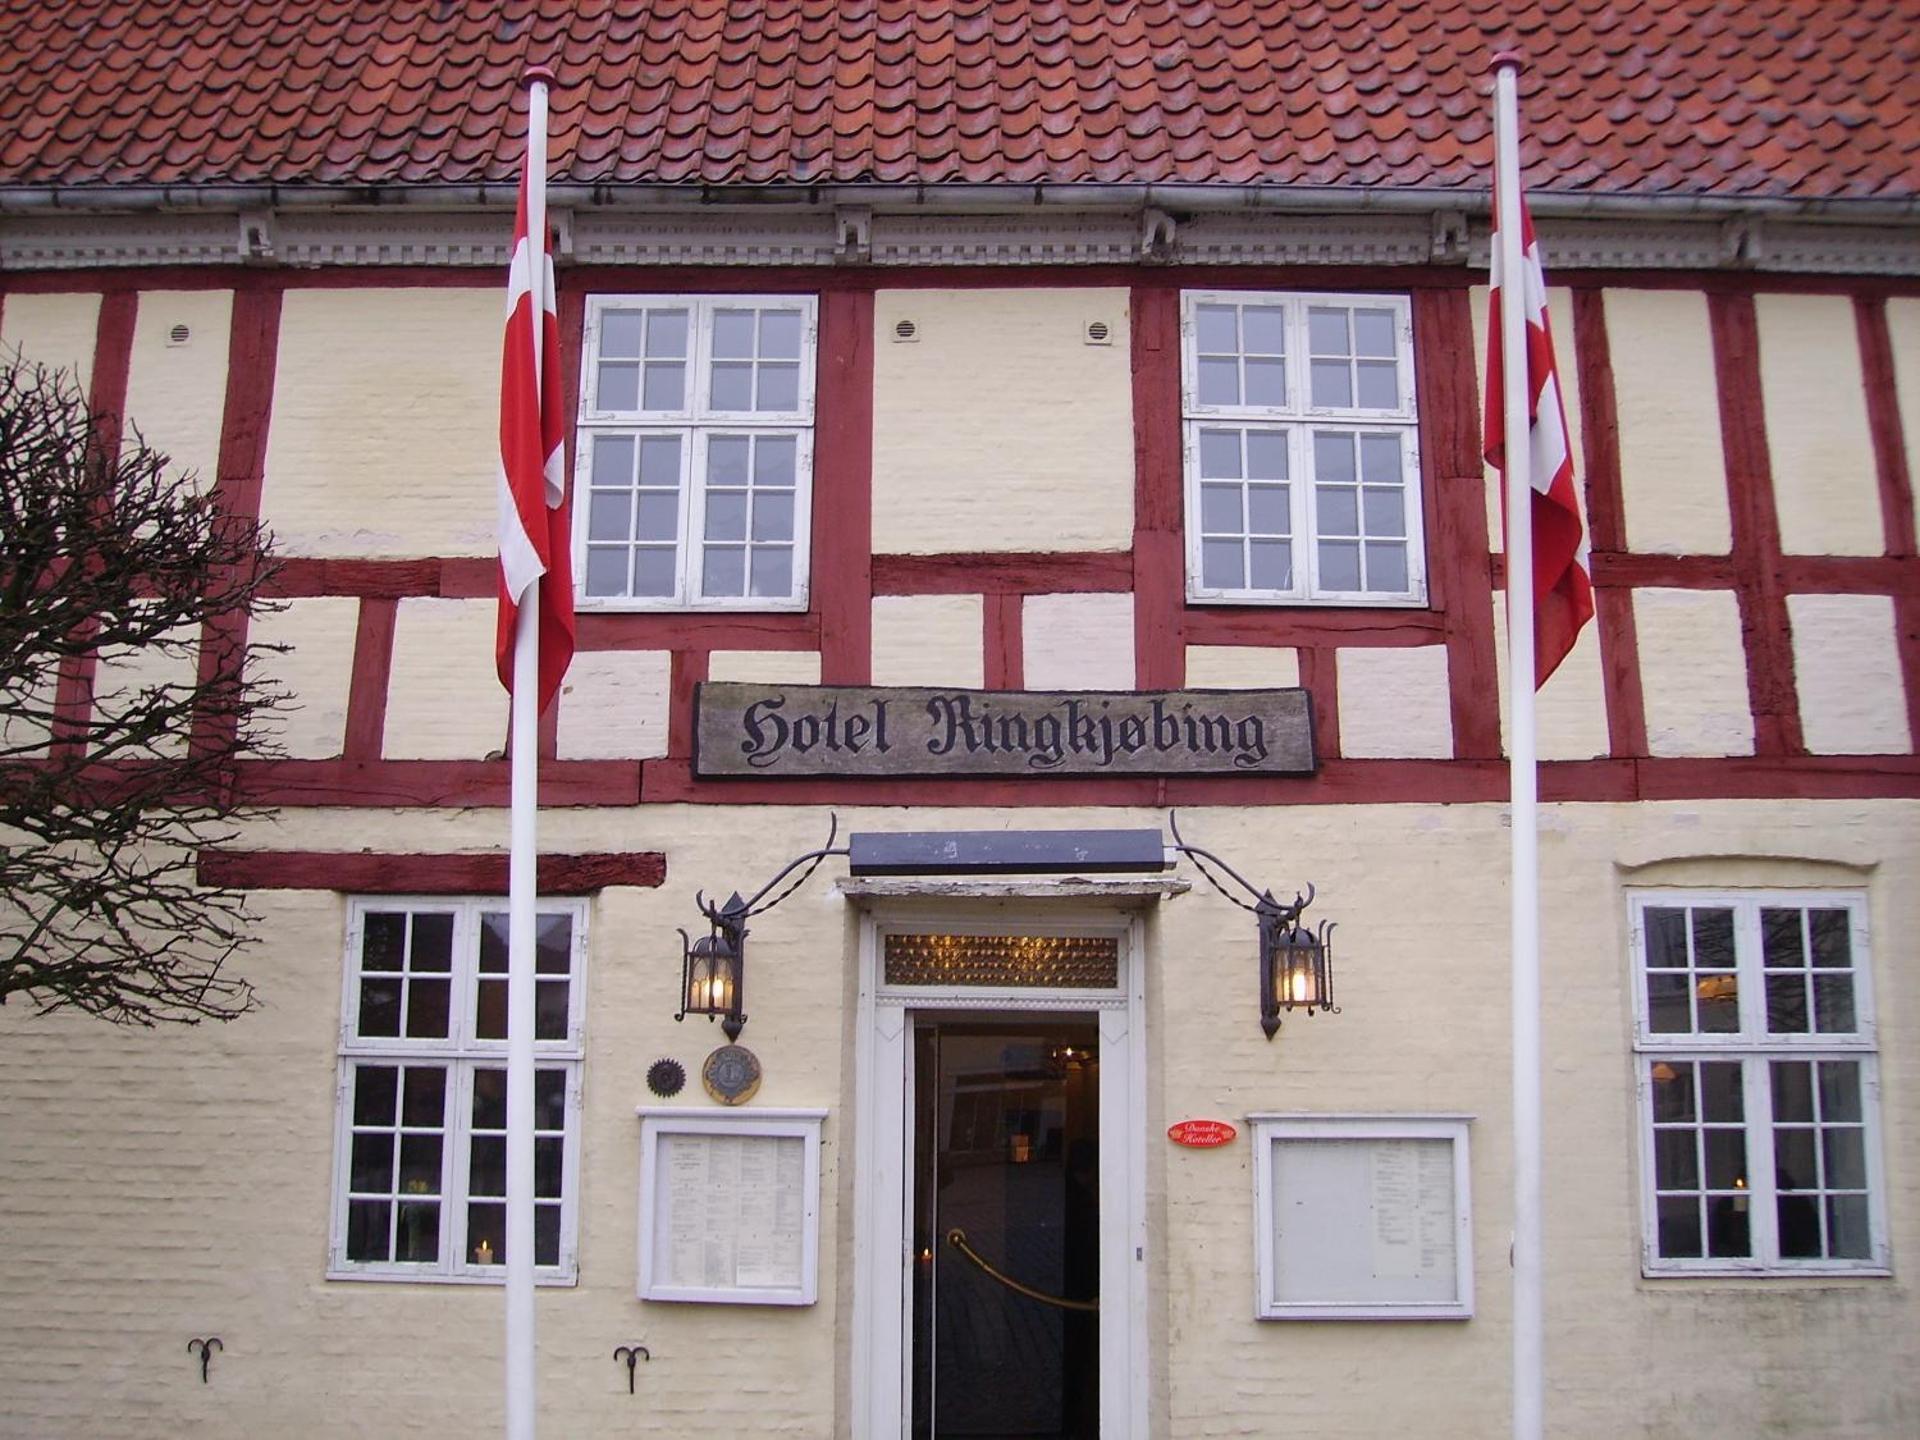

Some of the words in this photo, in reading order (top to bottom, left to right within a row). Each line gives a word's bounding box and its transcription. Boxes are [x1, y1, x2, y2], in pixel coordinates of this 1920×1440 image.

[741, 695, 893, 767] Hotel
[926, 694, 1269, 768] Ringkjøbing
[1183, 1132, 1222, 1144] Hoteller
